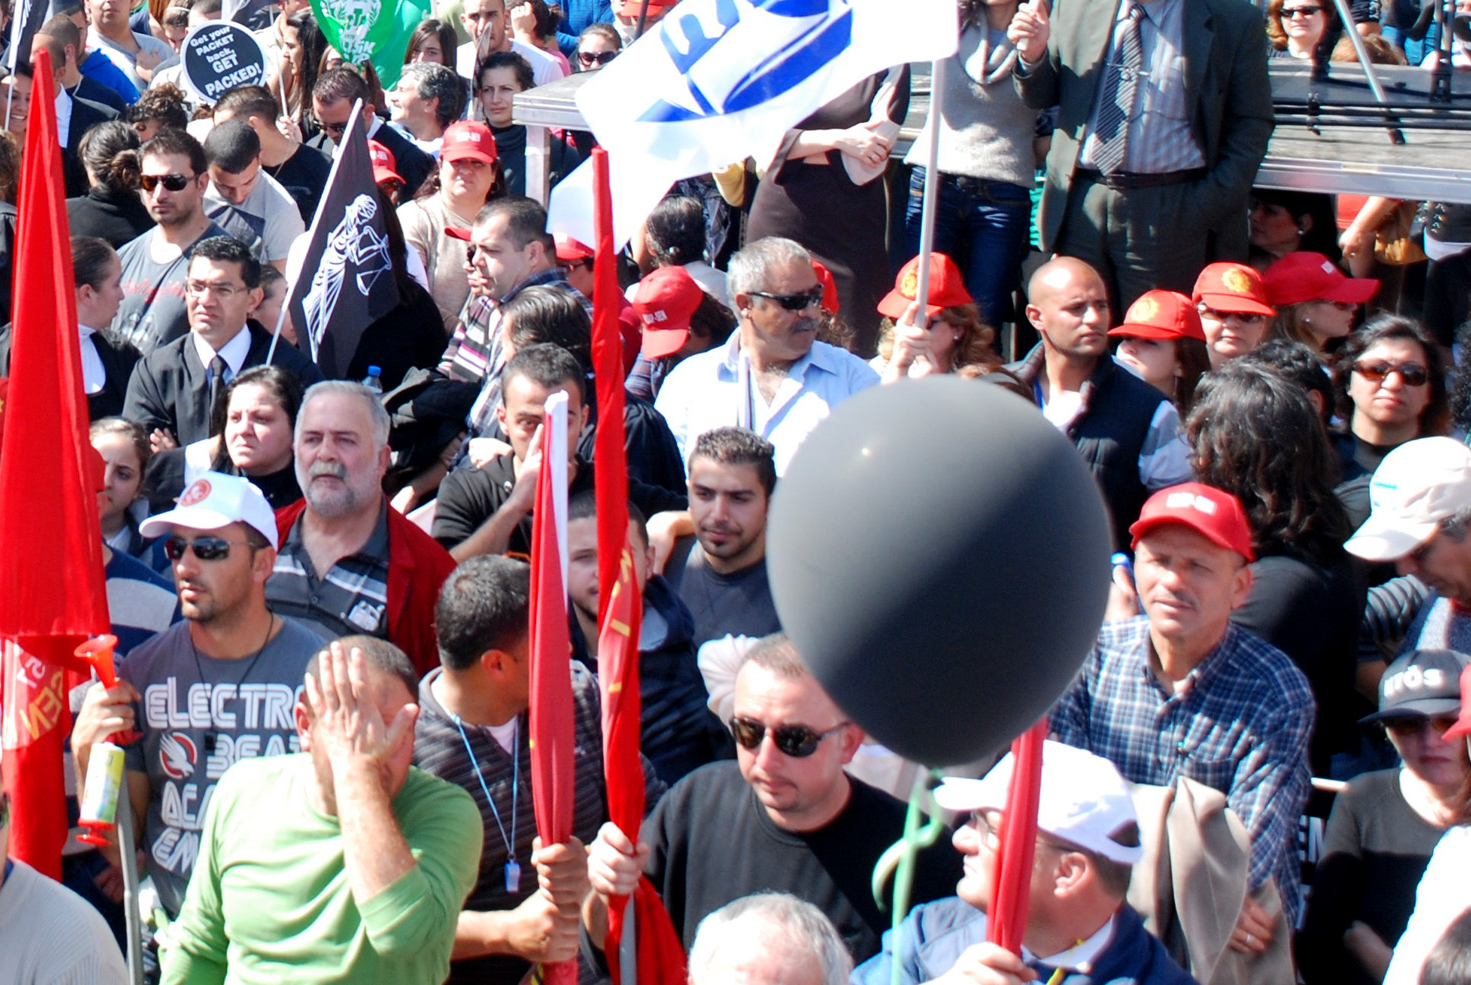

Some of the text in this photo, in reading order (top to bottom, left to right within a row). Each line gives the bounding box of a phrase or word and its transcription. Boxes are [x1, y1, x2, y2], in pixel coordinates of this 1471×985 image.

[190, 26, 230, 47] Get your
[195, 34, 234, 56] PACKET
[206, 47, 235, 63] back,
[212, 54, 238, 73] GET
[205, 62, 262, 96] PACKED!
